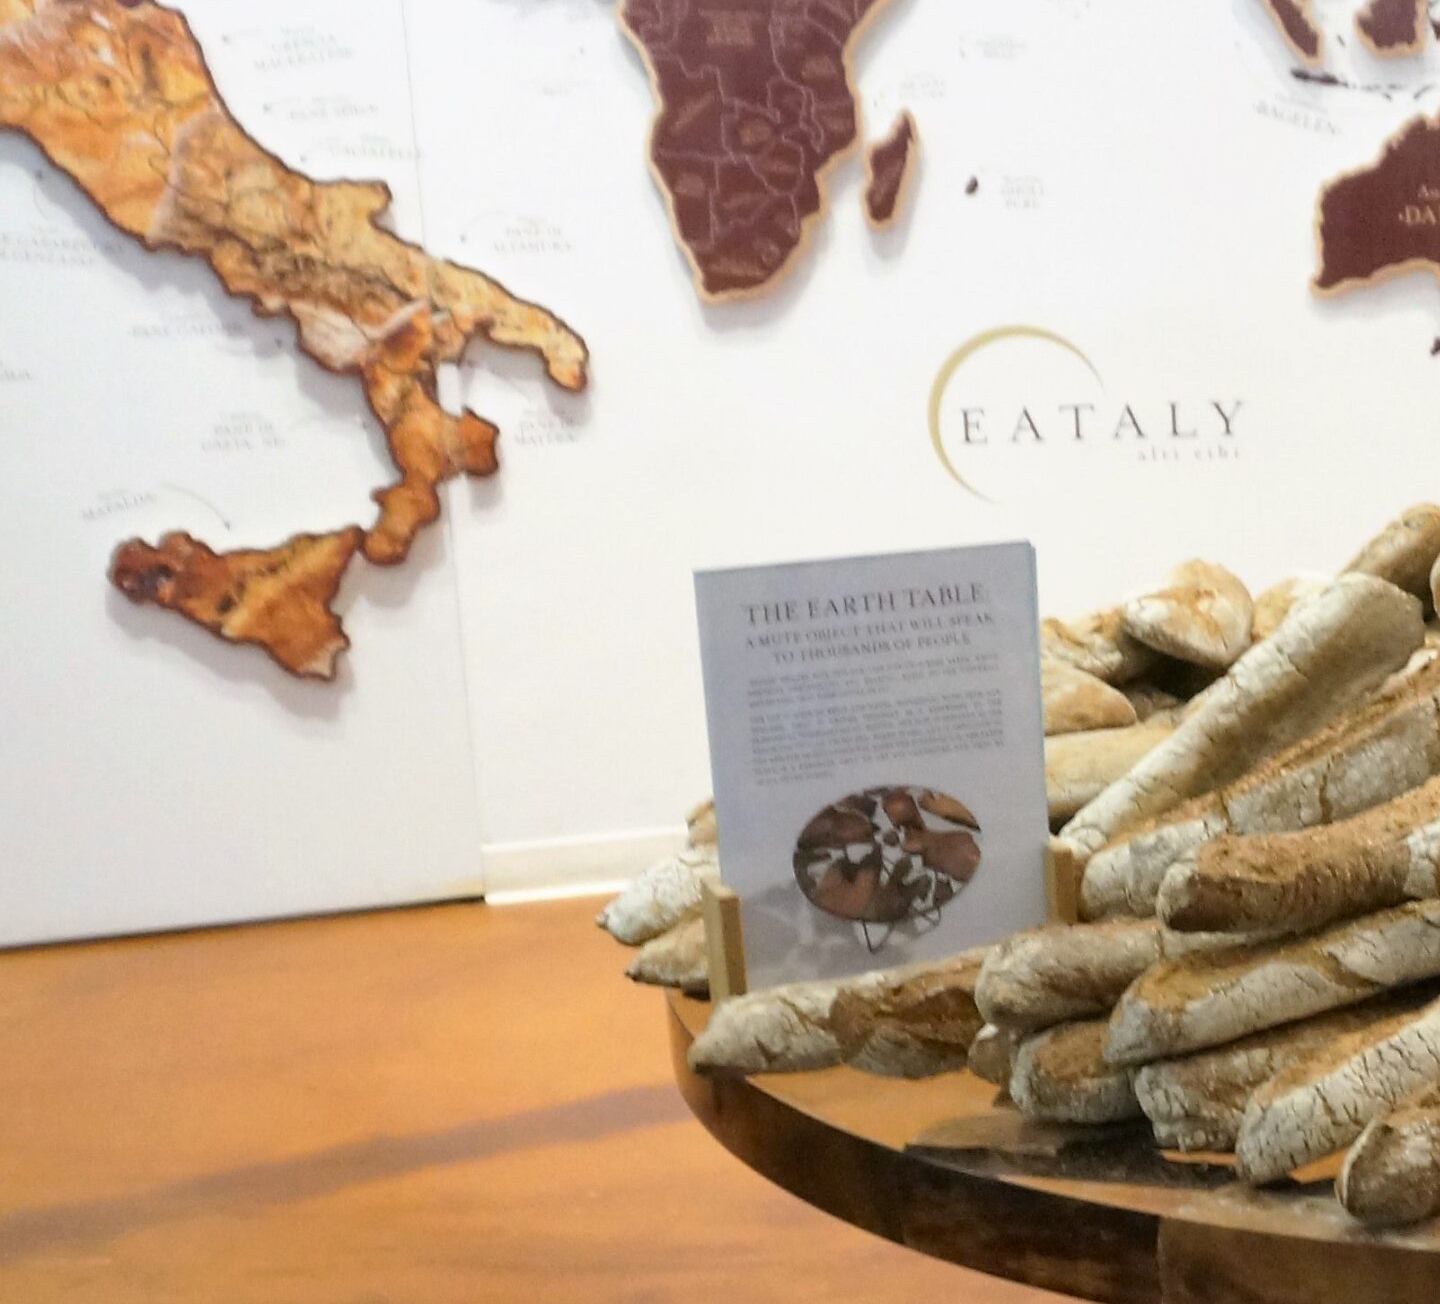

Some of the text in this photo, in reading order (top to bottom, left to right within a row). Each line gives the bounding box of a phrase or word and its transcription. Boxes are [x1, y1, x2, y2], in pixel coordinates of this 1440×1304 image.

[960, 399, 1245, 446] EATALY
[741, 582, 985, 626] THE EARTH TABLE
